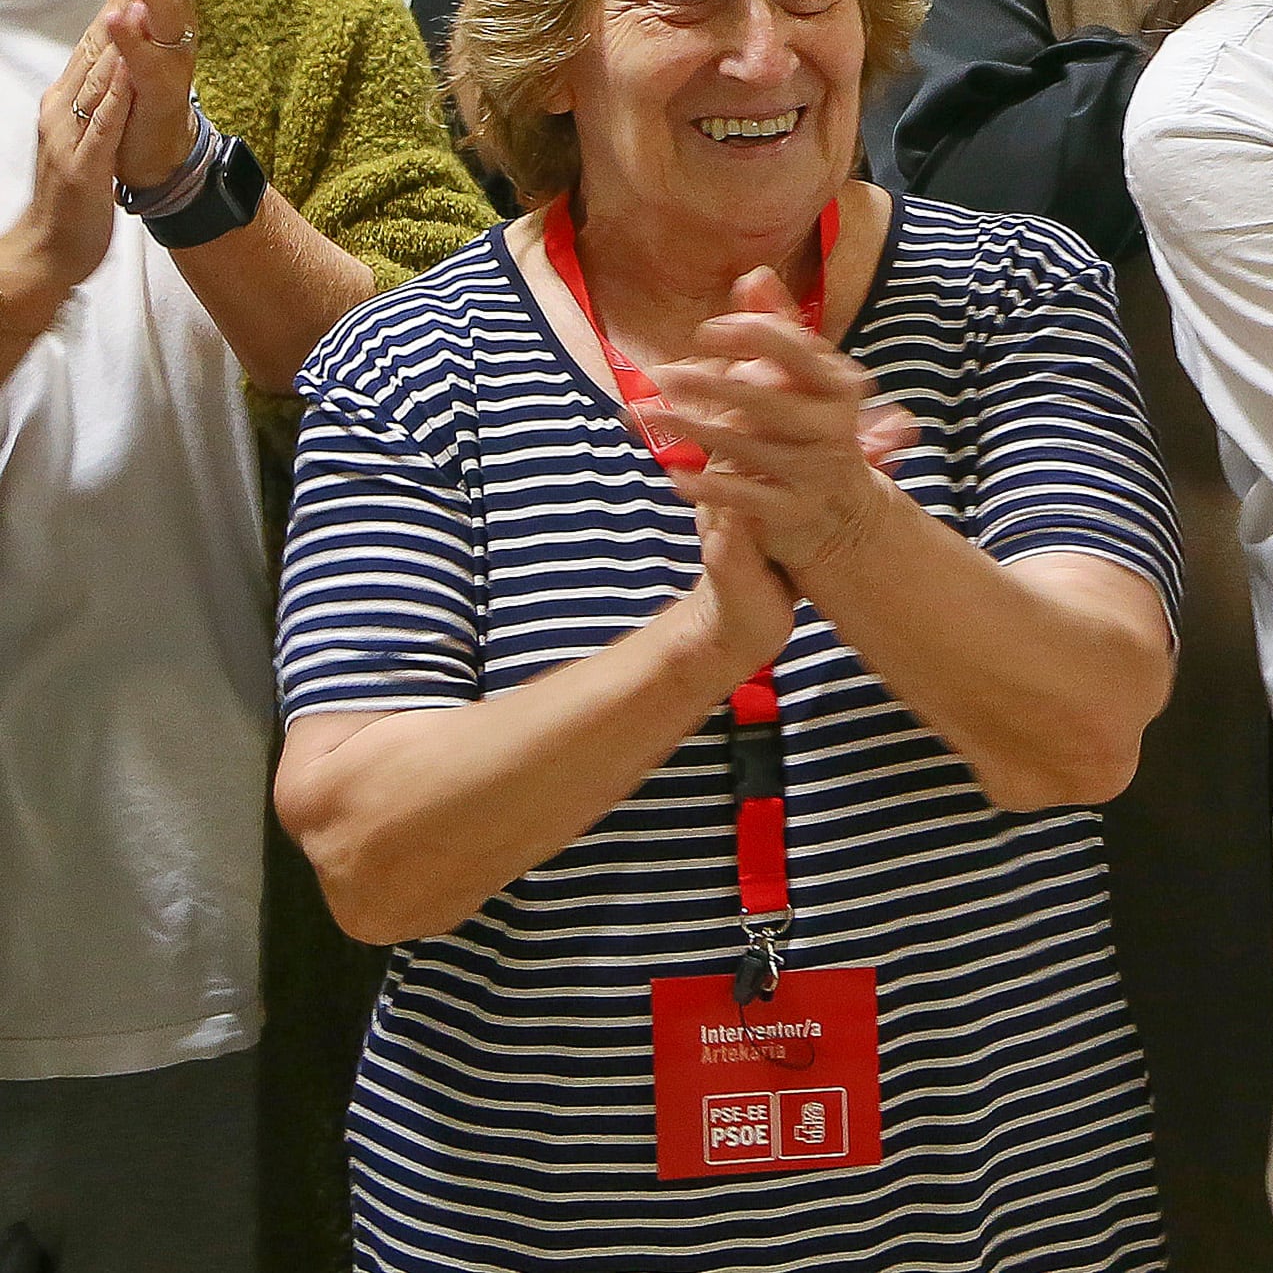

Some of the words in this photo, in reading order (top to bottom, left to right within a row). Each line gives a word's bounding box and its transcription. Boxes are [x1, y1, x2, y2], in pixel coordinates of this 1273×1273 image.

[700, 1019, 822, 1044] Interventor/a
[700, 1042, 786, 1064] Artekaria
[709, 1105, 768, 1123] PSE-EE
[710, 1124, 769, 1148] PSOE
